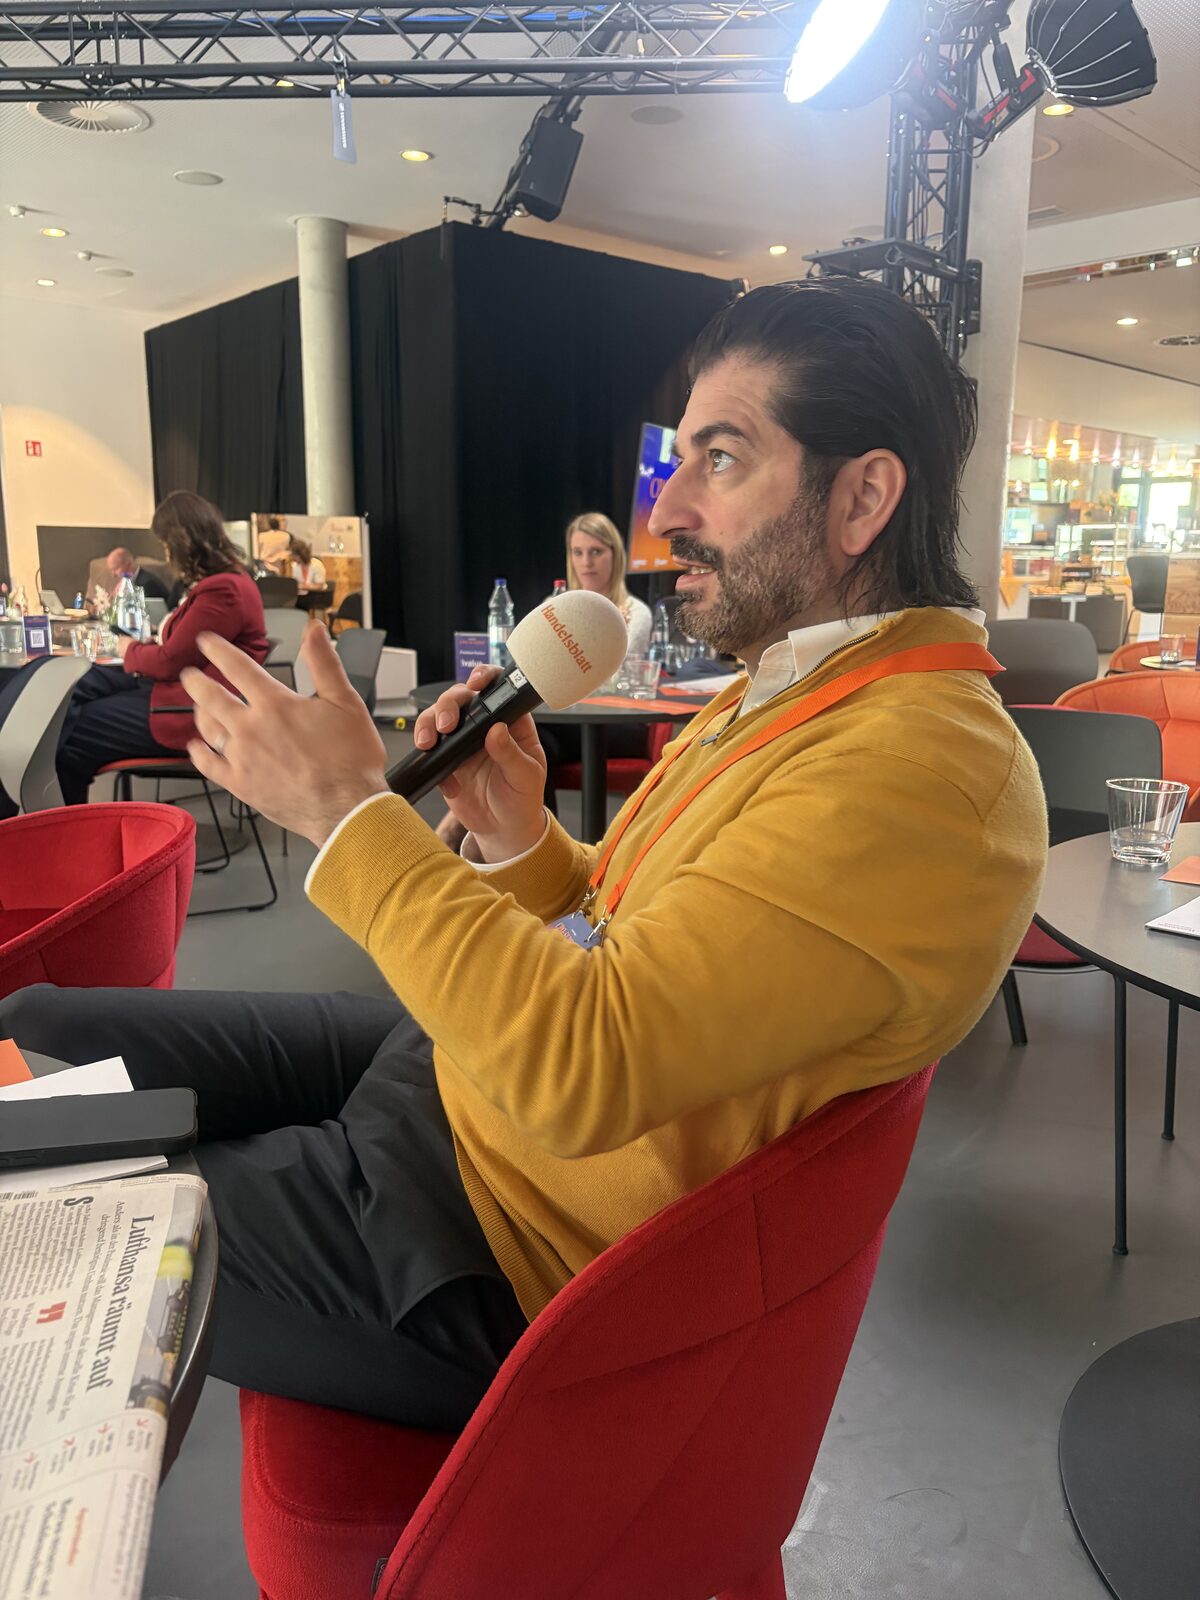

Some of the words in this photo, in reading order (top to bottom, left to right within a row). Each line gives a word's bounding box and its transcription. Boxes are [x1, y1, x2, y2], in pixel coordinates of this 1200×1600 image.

[541, 604, 592, 674] Handelsblatt
[112, 1214, 155, 1296] Lufthansa
[96, 1297, 132, 1356] räumt
[86, 1357, 114, 1394] auf
